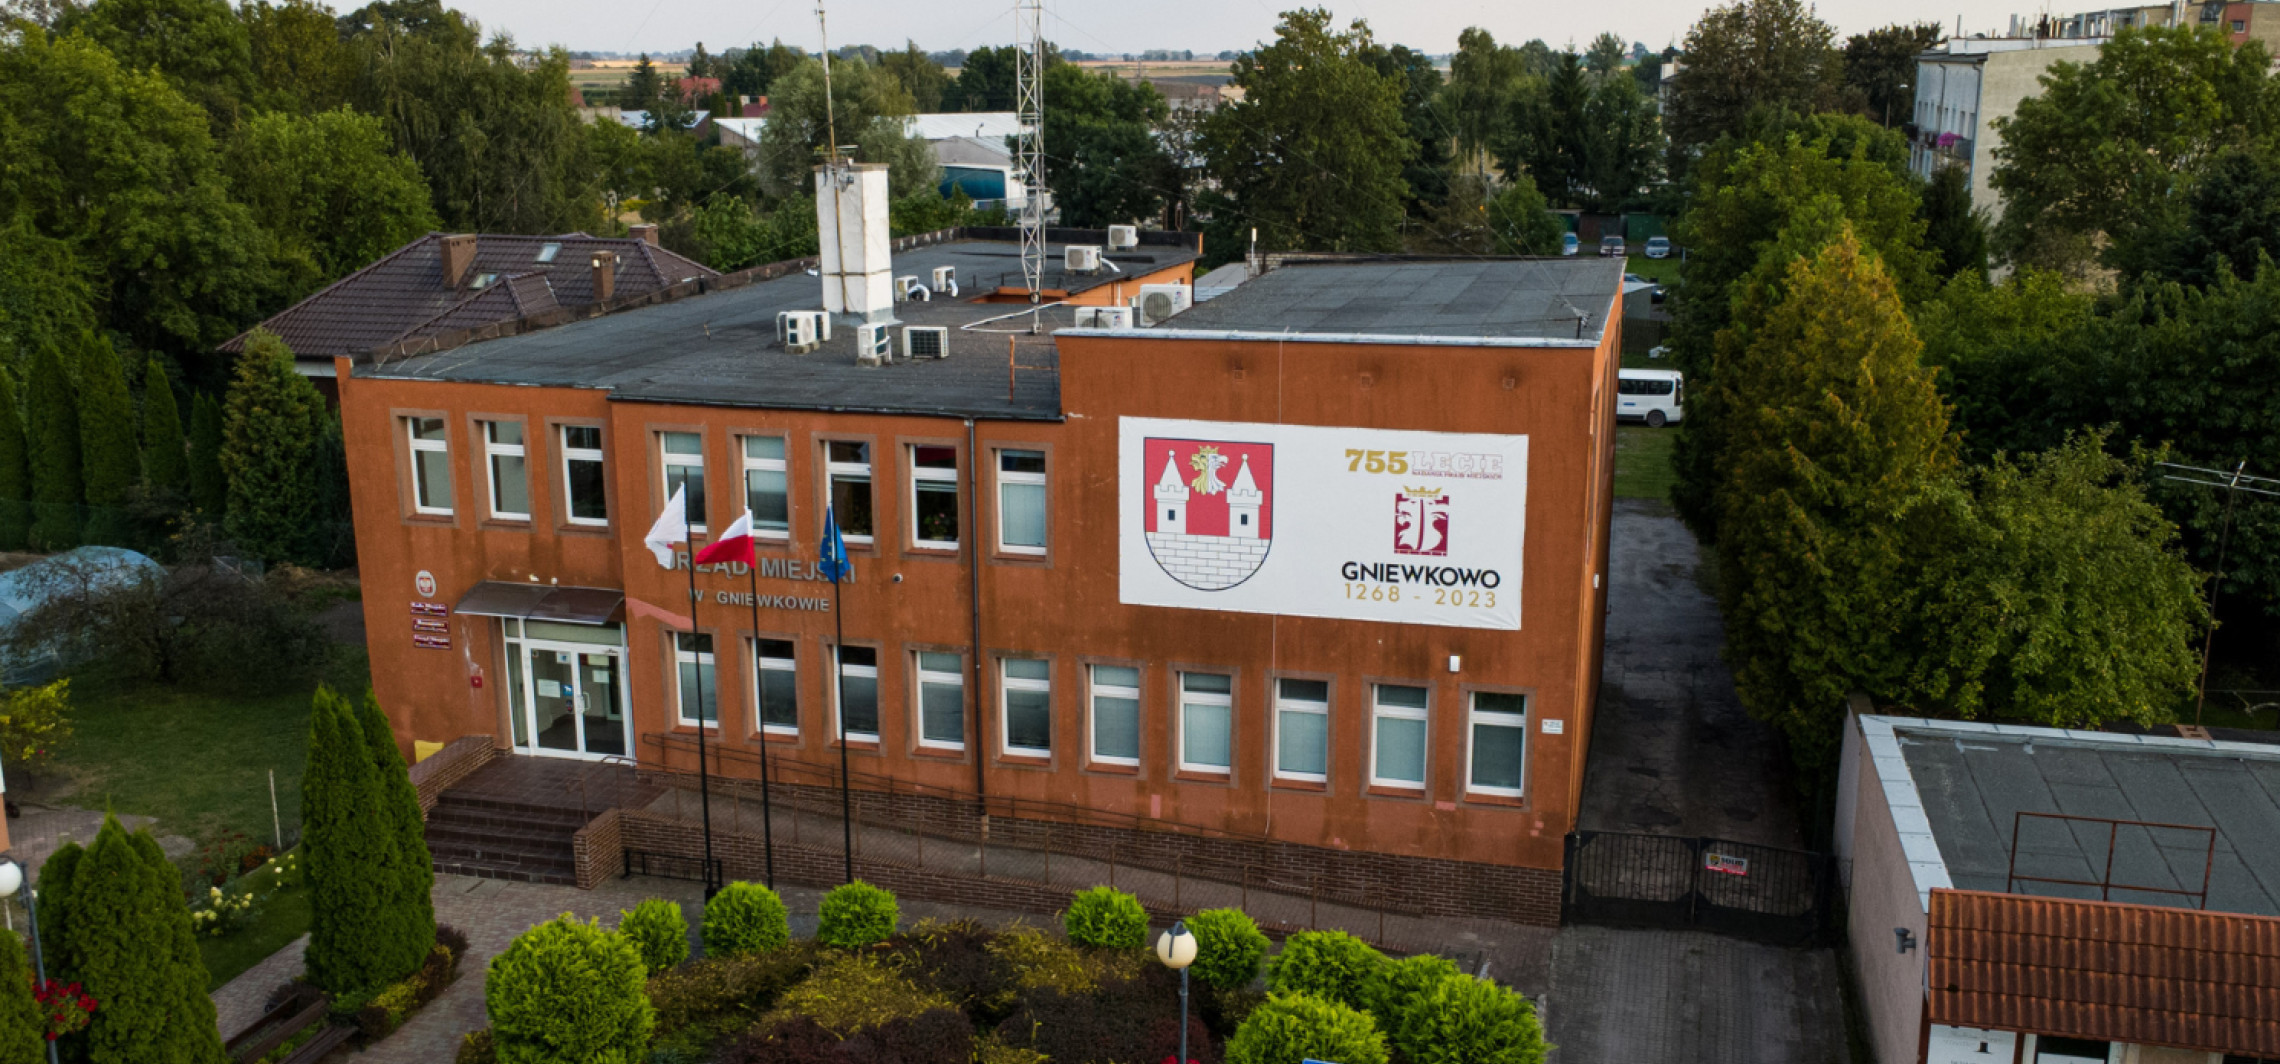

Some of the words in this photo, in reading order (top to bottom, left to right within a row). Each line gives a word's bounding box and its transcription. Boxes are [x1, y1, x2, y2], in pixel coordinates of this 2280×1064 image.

[1345, 449, 1408, 475] 755
[1412, 451, 1503, 475] LECIE
[761, 557, 856, 584] MIEJI
[1342, 561, 1501, 589] GNIEWKOWO
[689, 588, 704, 602] W
[716, 590, 830, 612] GNIEWKOWIE
[1345, 583, 1400, 602] 1268
[1434, 588, 1496, 608] 2023
